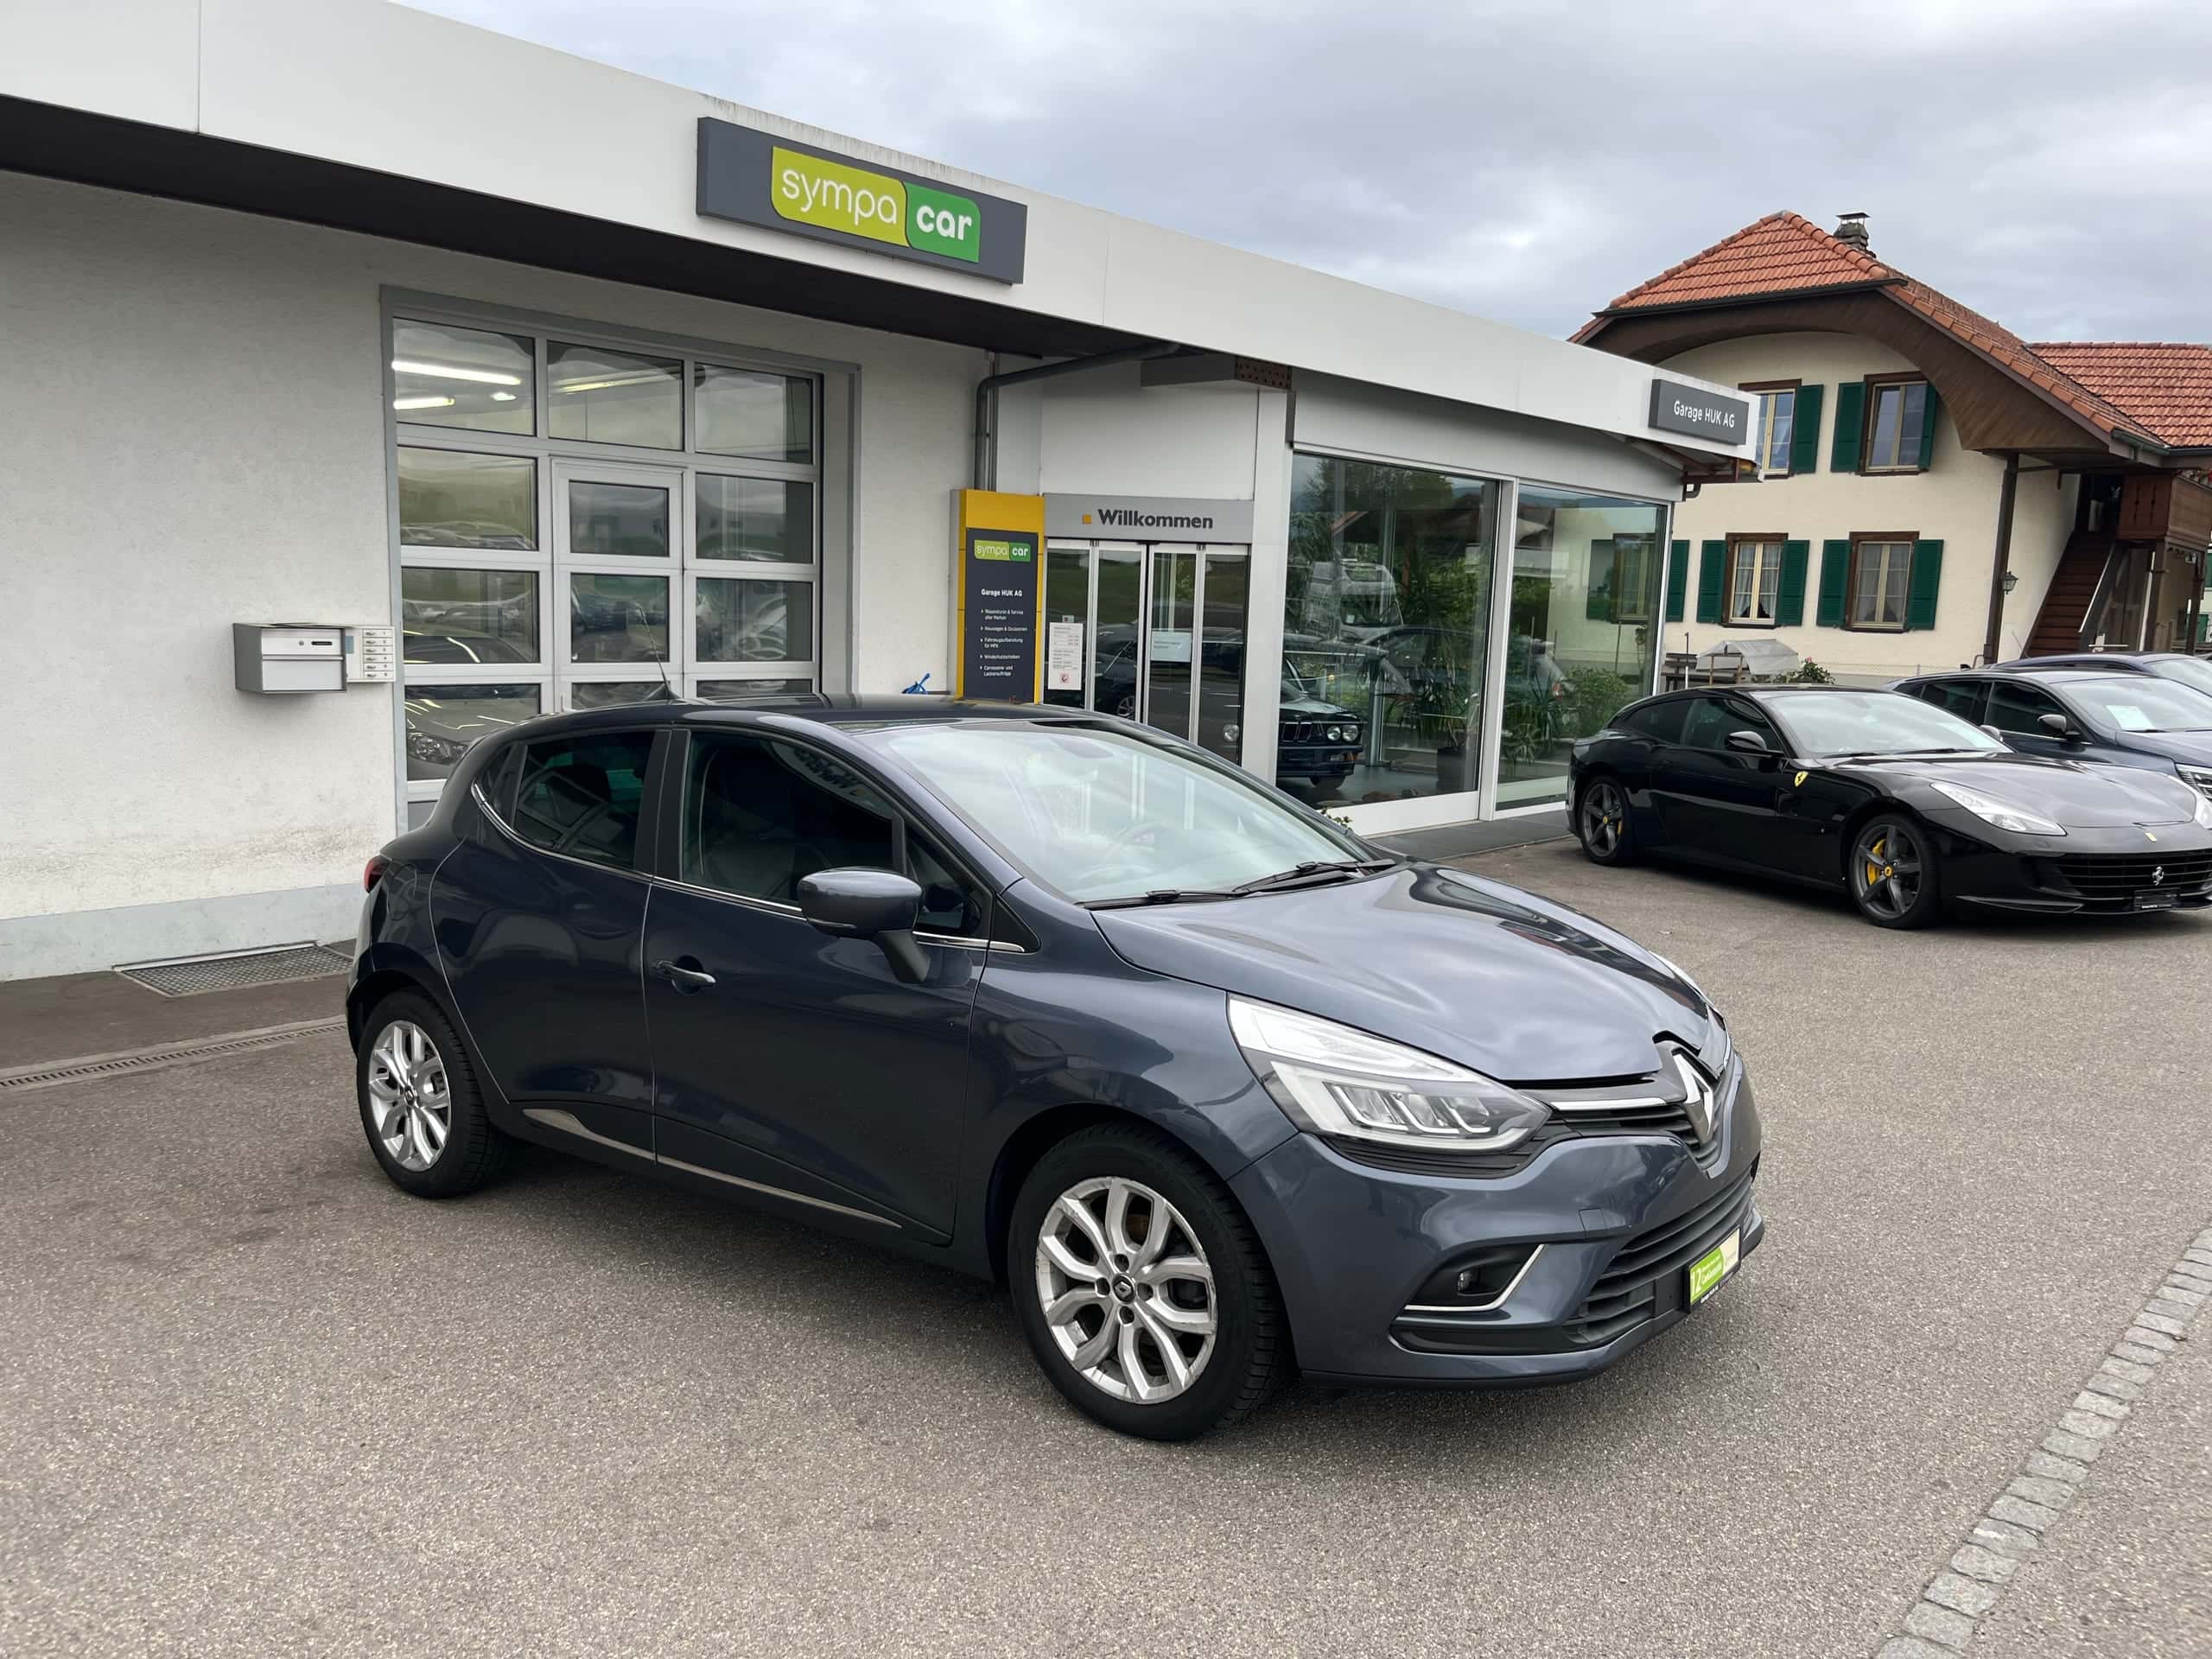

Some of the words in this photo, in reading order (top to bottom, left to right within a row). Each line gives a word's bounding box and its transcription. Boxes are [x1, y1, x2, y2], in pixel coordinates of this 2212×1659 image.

[781, 169, 897, 226] sympa
[916, 205, 972, 241] car
[1674, 400, 1703, 422] Garage
[1705, 407, 1722, 425] HUK
[1723, 412, 1735, 428] AG
[1097, 509, 1213, 529] Willkommen
[976, 545, 1007, 557] sympa
[1012, 547, 1028, 556] car
[981, 588, 1001, 597] Garage
